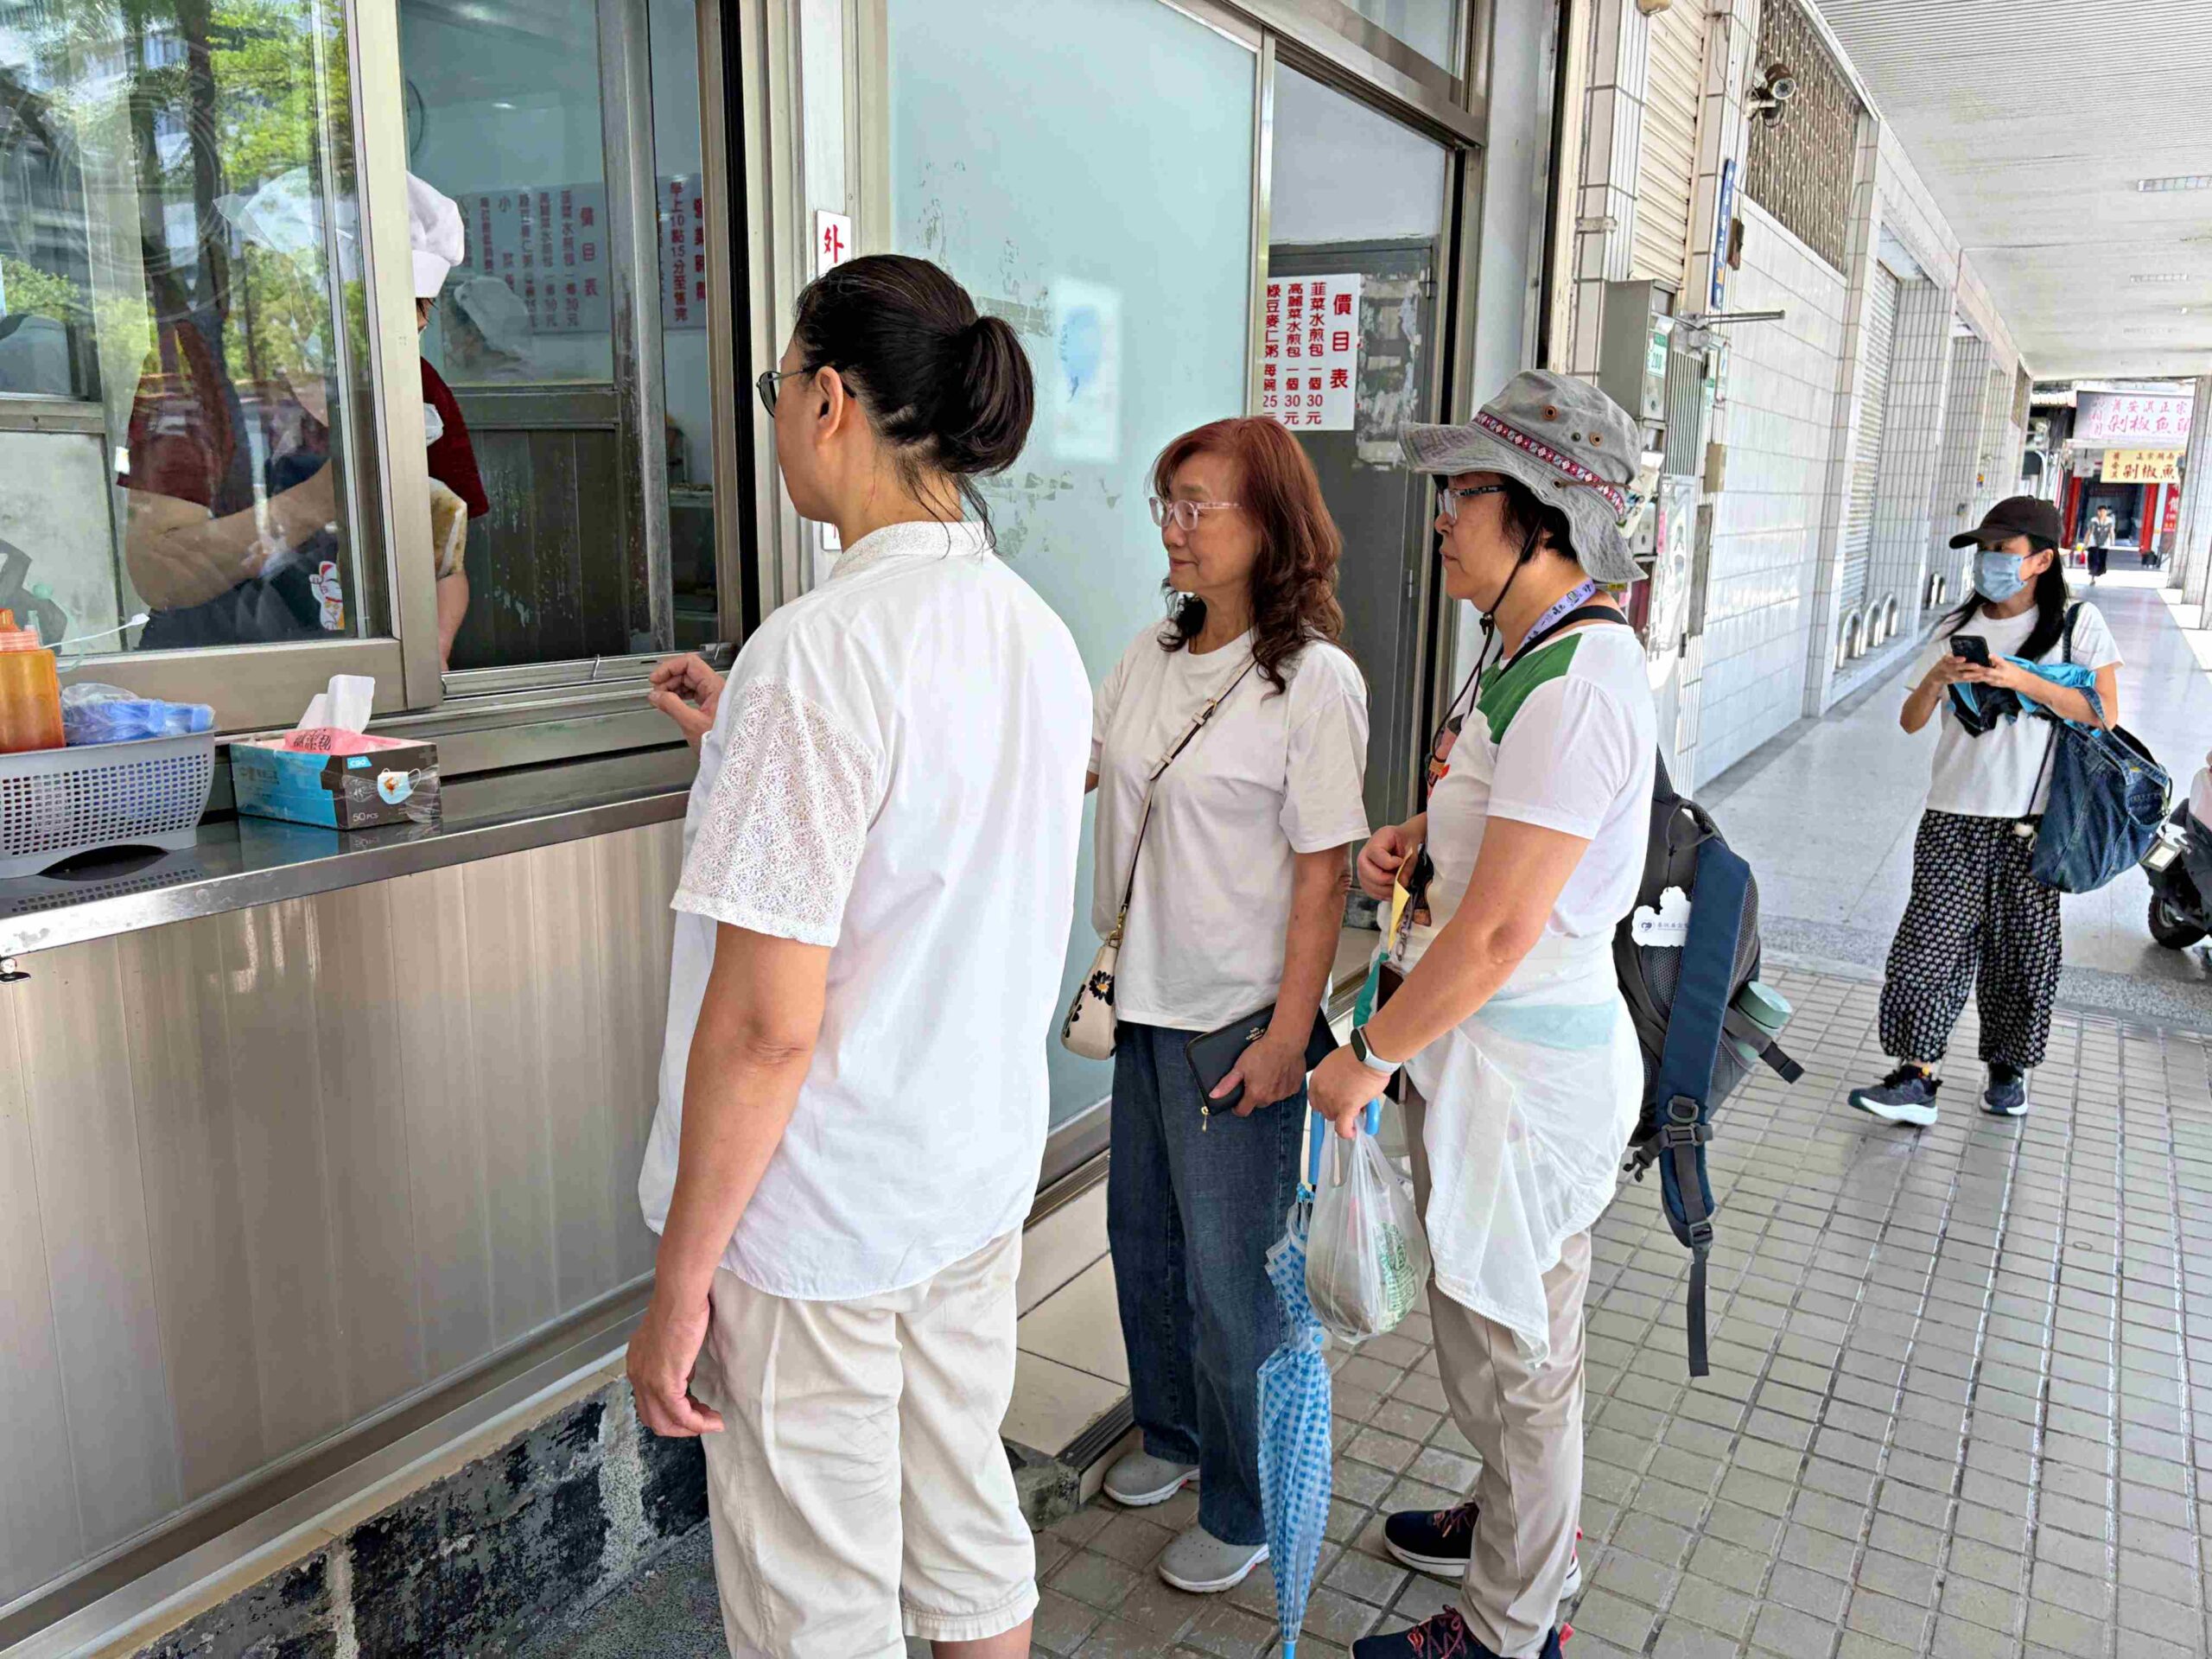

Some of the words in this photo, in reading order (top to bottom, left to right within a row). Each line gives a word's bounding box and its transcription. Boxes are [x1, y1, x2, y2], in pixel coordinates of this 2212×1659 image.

[823, 224, 844, 264] 外
[1330, 294, 1351, 389] 價目表
[353, 812, 365, 822] 50
